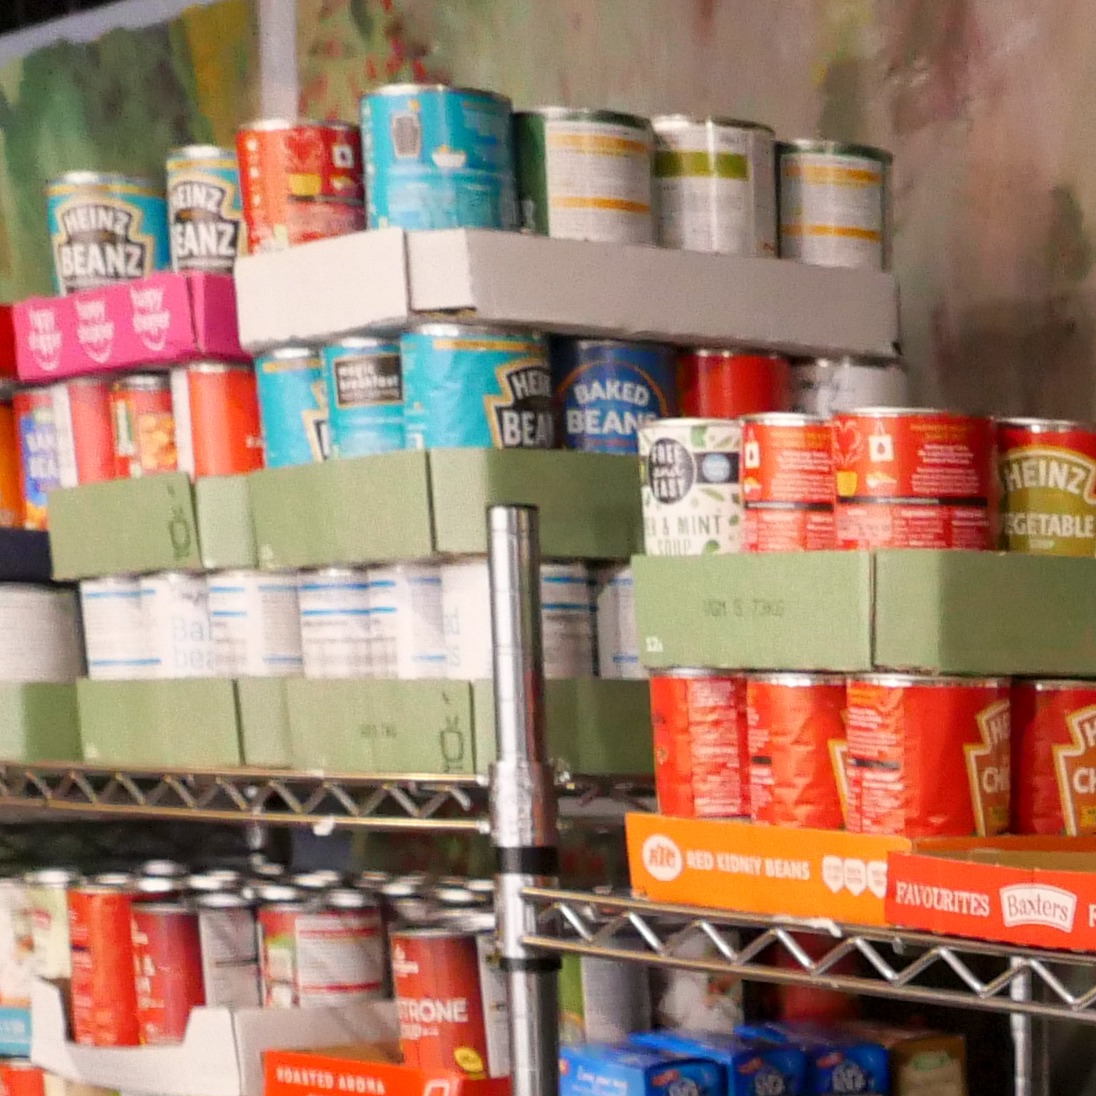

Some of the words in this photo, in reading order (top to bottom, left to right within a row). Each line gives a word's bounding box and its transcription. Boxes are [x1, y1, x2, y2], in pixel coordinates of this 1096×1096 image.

[62, 204, 133, 236] HEINZ
[176, 223, 235, 257] EANZ
[61, 242, 144, 278] BEANZ
[574, 378, 650, 407] BAKED
[1006, 459, 1086, 495] HEINZ
[677, 514, 722, 535] MINT
[686, 849, 714, 871] RED
[716, 852, 762, 877] KIDNEY
[765, 857, 811, 881] BEANS
[895, 881, 990, 918] FAVOURITES
[1007, 894, 1068, 923] Baxters
